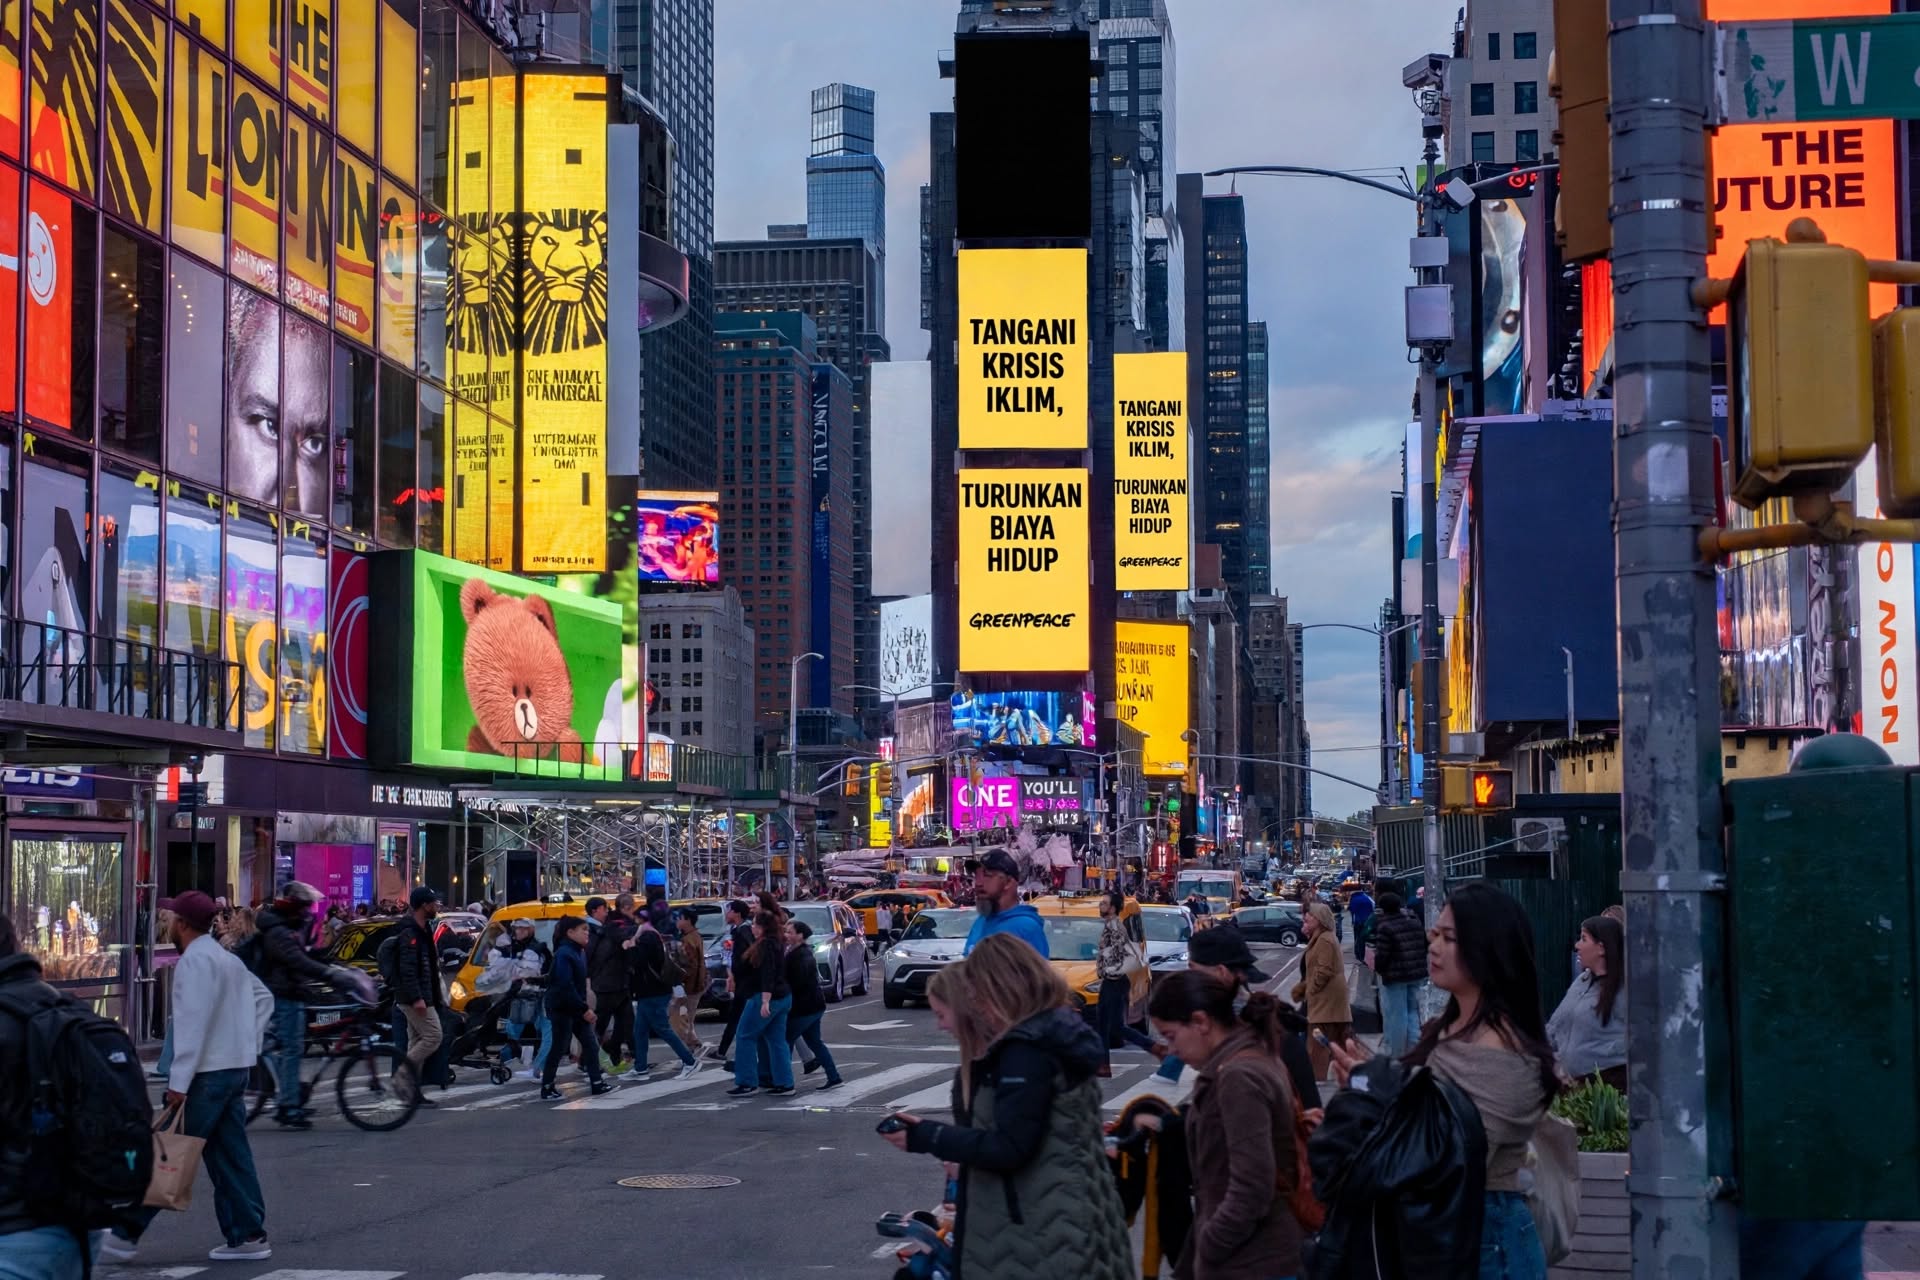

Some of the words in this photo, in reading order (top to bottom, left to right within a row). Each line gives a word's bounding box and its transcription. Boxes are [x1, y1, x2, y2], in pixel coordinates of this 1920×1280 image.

[1810, 31, 1871, 106] W
[187, 12, 298, 215] LION
[306, 102, 404, 280] KING
[1762, 128, 1864, 166] THE
[970, 319, 1075, 344] TANGANI
[983, 352, 1064, 378] KRISIS
[987, 387, 1063, 417] IKLIM,
[1119, 400, 1181, 416] TANGANI
[1126, 421, 1175, 437] KRISIS
[1129, 441, 1174, 459] IKLIM,
[961, 483, 1082, 507] TURUNKAN
[1115, 479, 1186, 494] TURUNKAN
[1131, 498, 1169, 514] BIAYA
[990, 515, 1055, 540] BIAYA
[1129, 518, 1172, 533] HIDUP
[987, 547, 1058, 572] HIDUP
[1119, 557, 1182, 567] GREENPEACE
[969, 612, 1075, 630] GREENPEACE
[1879, 600, 1899, 744] NOW
[957, 785, 1013, 807] ONE
[1024, 781, 1078, 795] YOU'LL
